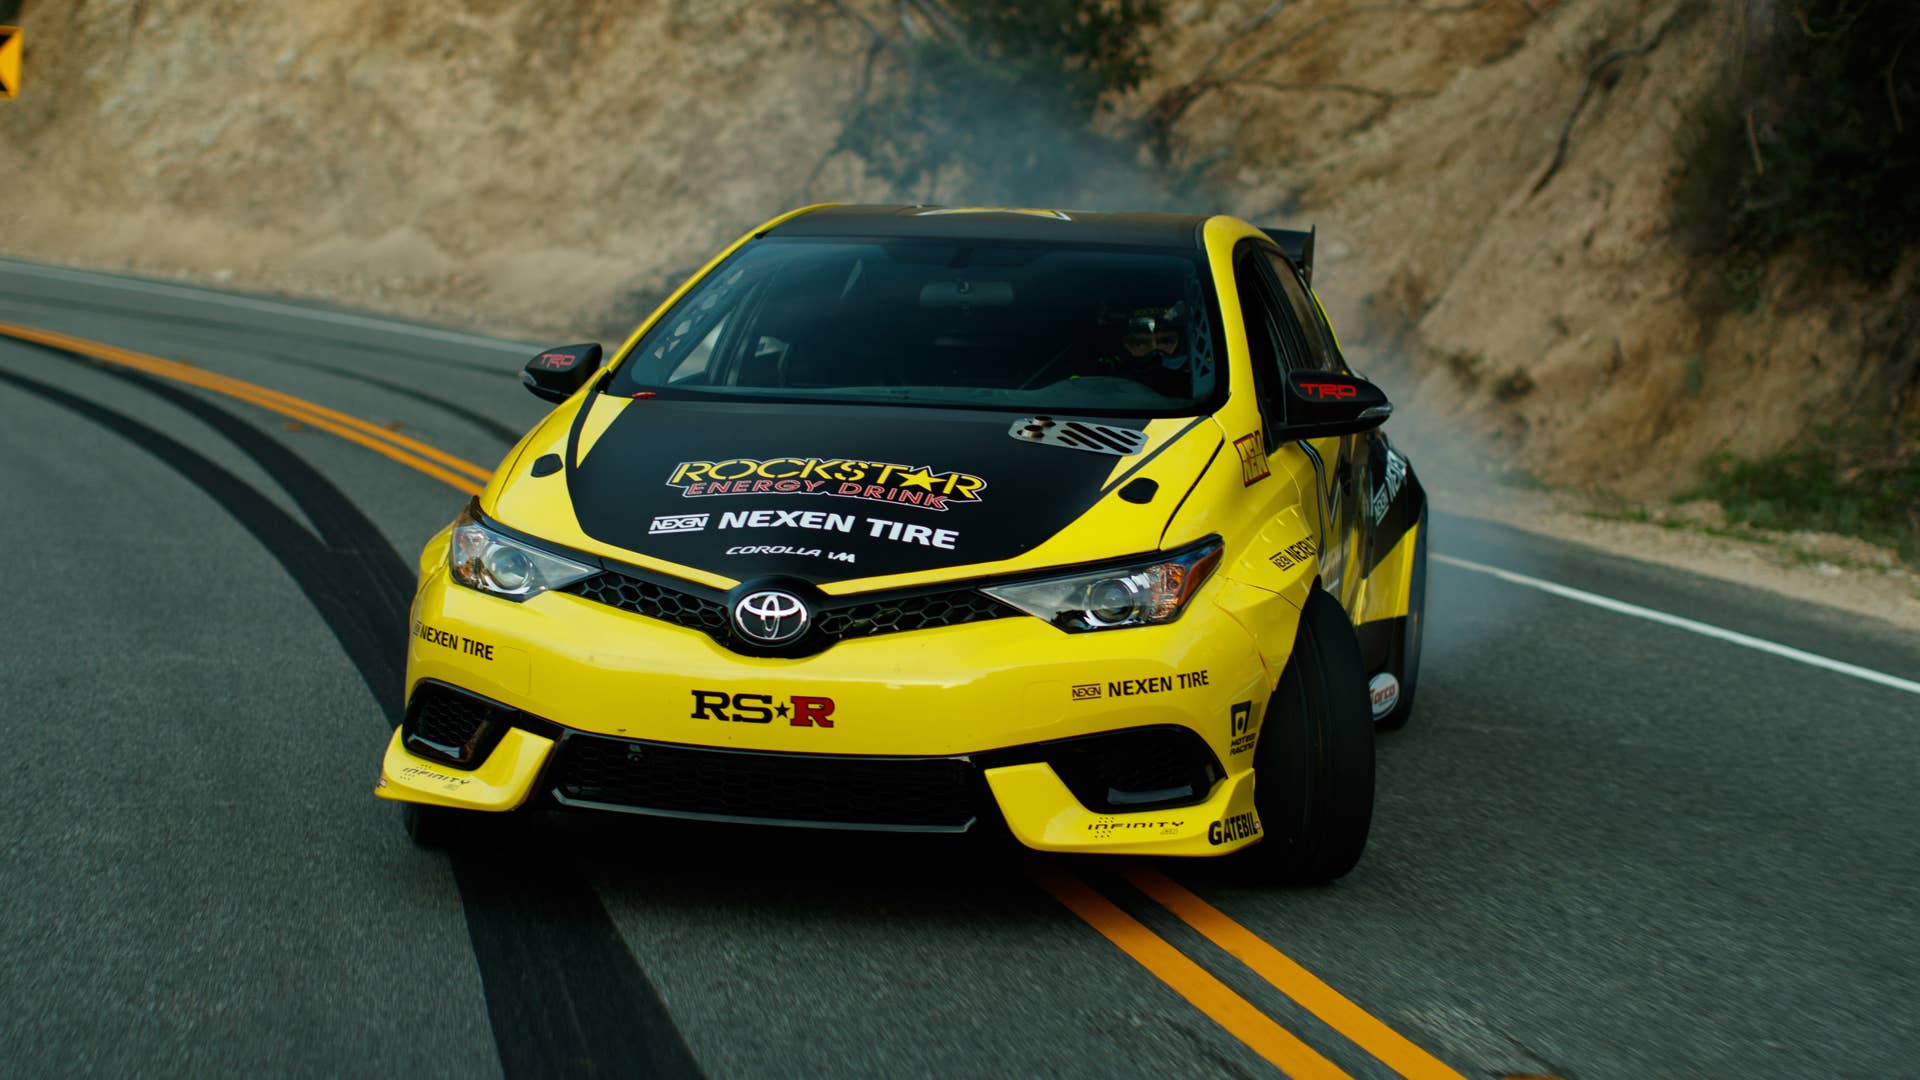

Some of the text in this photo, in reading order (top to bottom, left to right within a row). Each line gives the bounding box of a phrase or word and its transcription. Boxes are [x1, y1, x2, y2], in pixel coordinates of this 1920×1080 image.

[540, 353, 576, 369] TRD
[1300, 383, 1357, 399] TRD
[687, 479, 949, 508] ENERGY DRINK
[718, 510, 856, 533] NEXEN
[866, 517, 960, 550] TIRE
[725, 545, 822, 556] COROLLA
[420, 623, 459, 650] NEXEN
[463, 637, 495, 661] TIRE
[1108, 676, 1172, 698] NEXEN
[1177, 670, 1209, 689] TIRE
